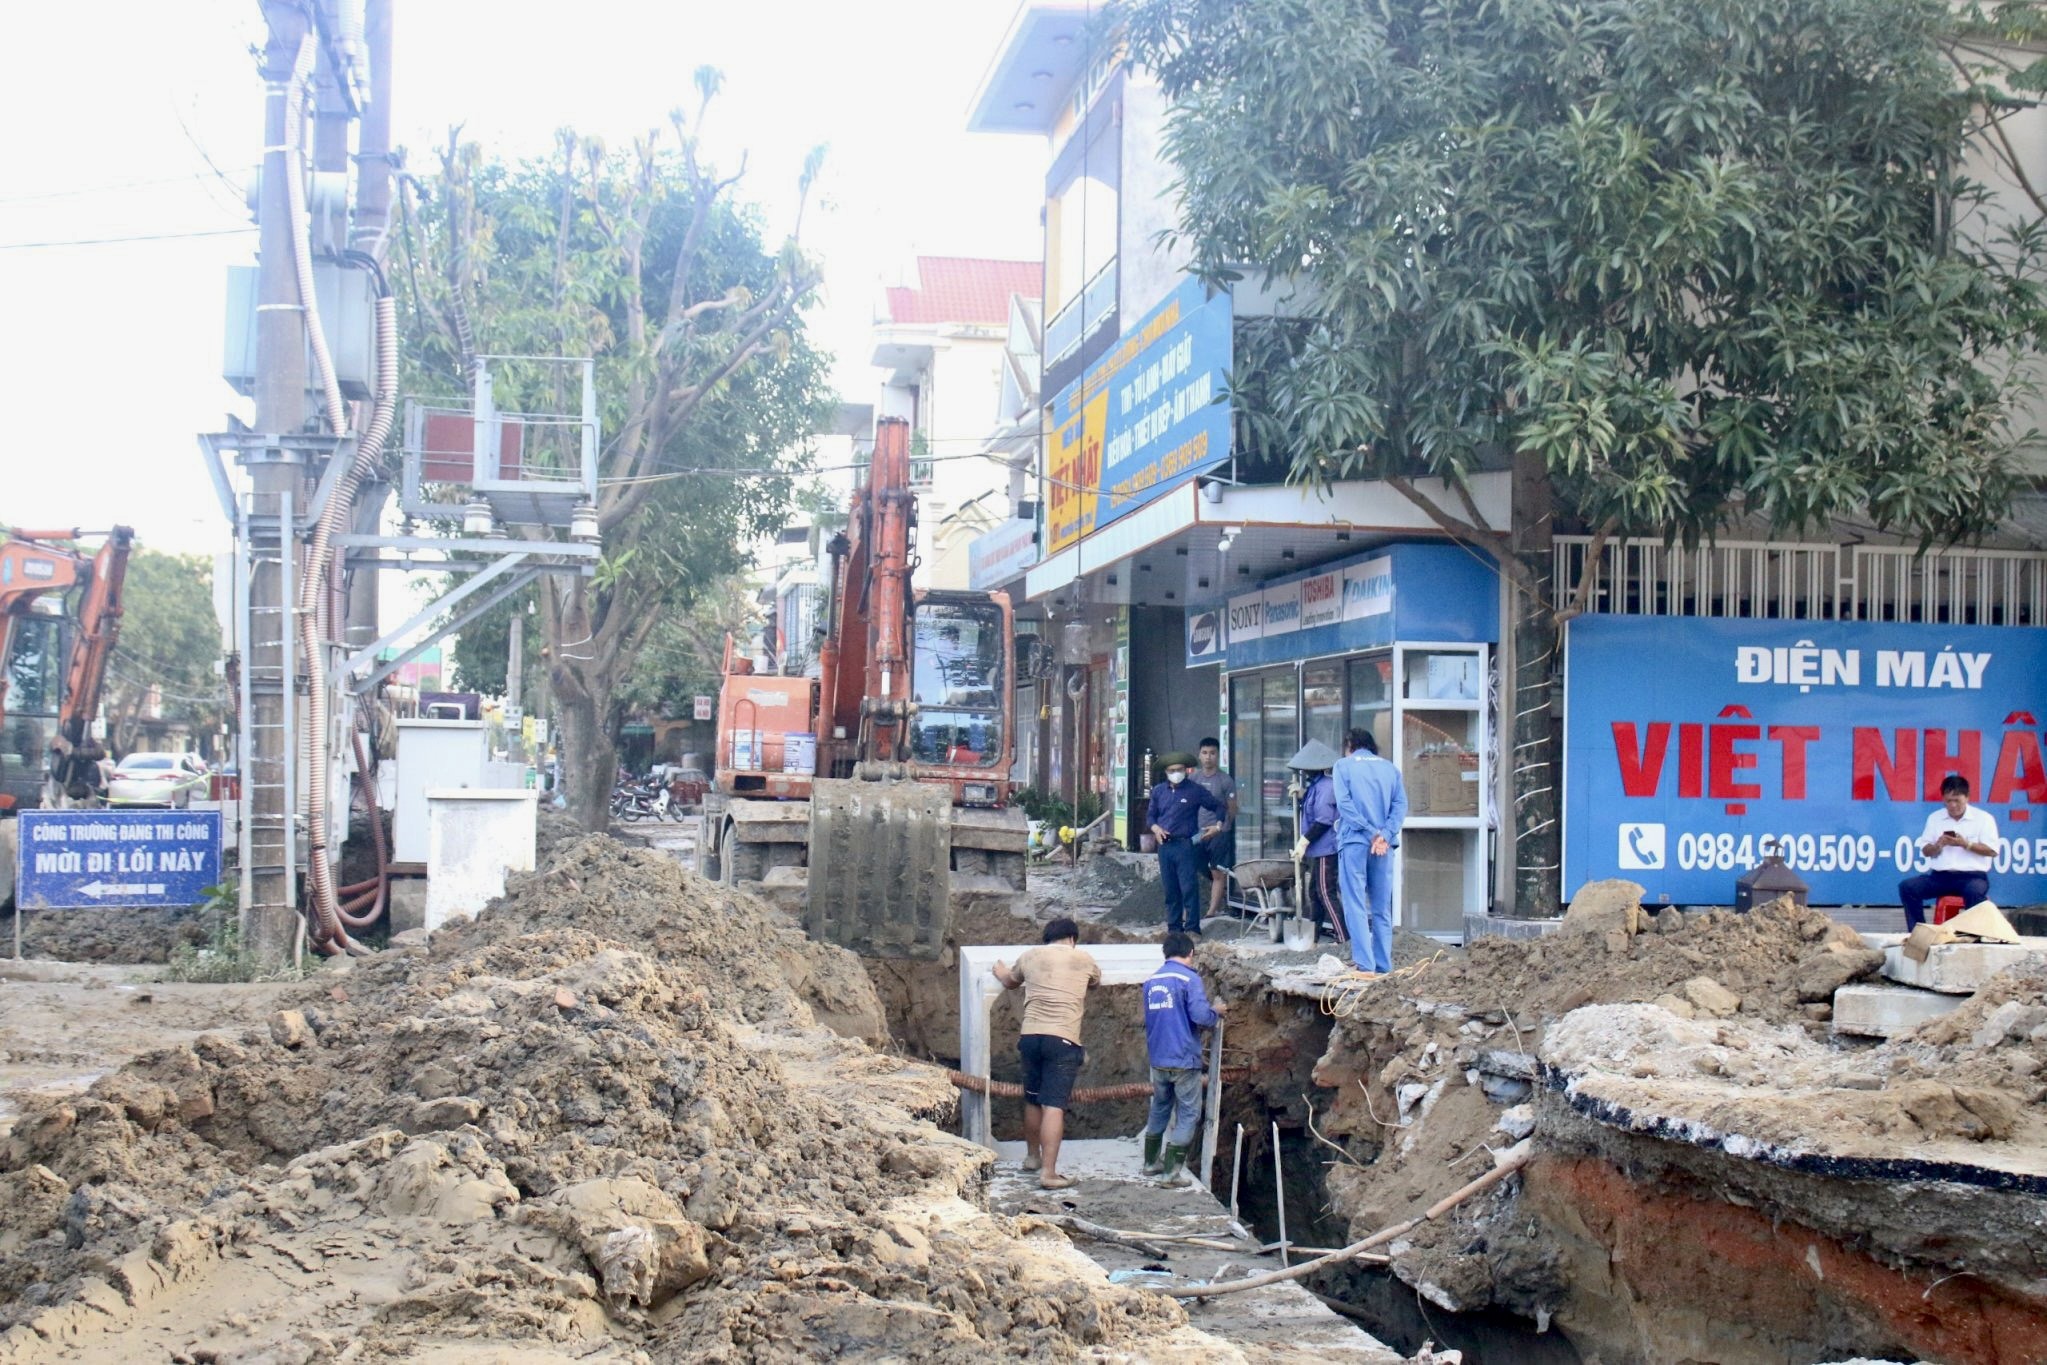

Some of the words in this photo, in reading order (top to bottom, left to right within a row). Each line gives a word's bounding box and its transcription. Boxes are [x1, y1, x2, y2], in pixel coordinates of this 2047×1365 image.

[1303, 575, 1335, 604] TOSHIBA
[1231, 602, 1261, 631] SONY
[1265, 595, 1299, 624] Panasonic
[1735, 640, 1860, 693] ĐIỆN
[1876, 645, 1992, 689] MÁY
[1611, 704, 1820, 815] VIỆT
[1852, 711, 2047, 822] NHẬ
[32, 822, 67, 841] CÔNG
[70, 821, 117, 841] TRƯỜNG
[119, 824, 153, 841] ĐANG
[155, 824, 174, 840] THI
[176, 821, 209, 841] CÔNG
[35, 846, 81, 873] MỜI
[87, 852, 112, 873] ĐI
[118, 845, 154, 872] LỐI
[160, 847, 206, 872] NÀY
